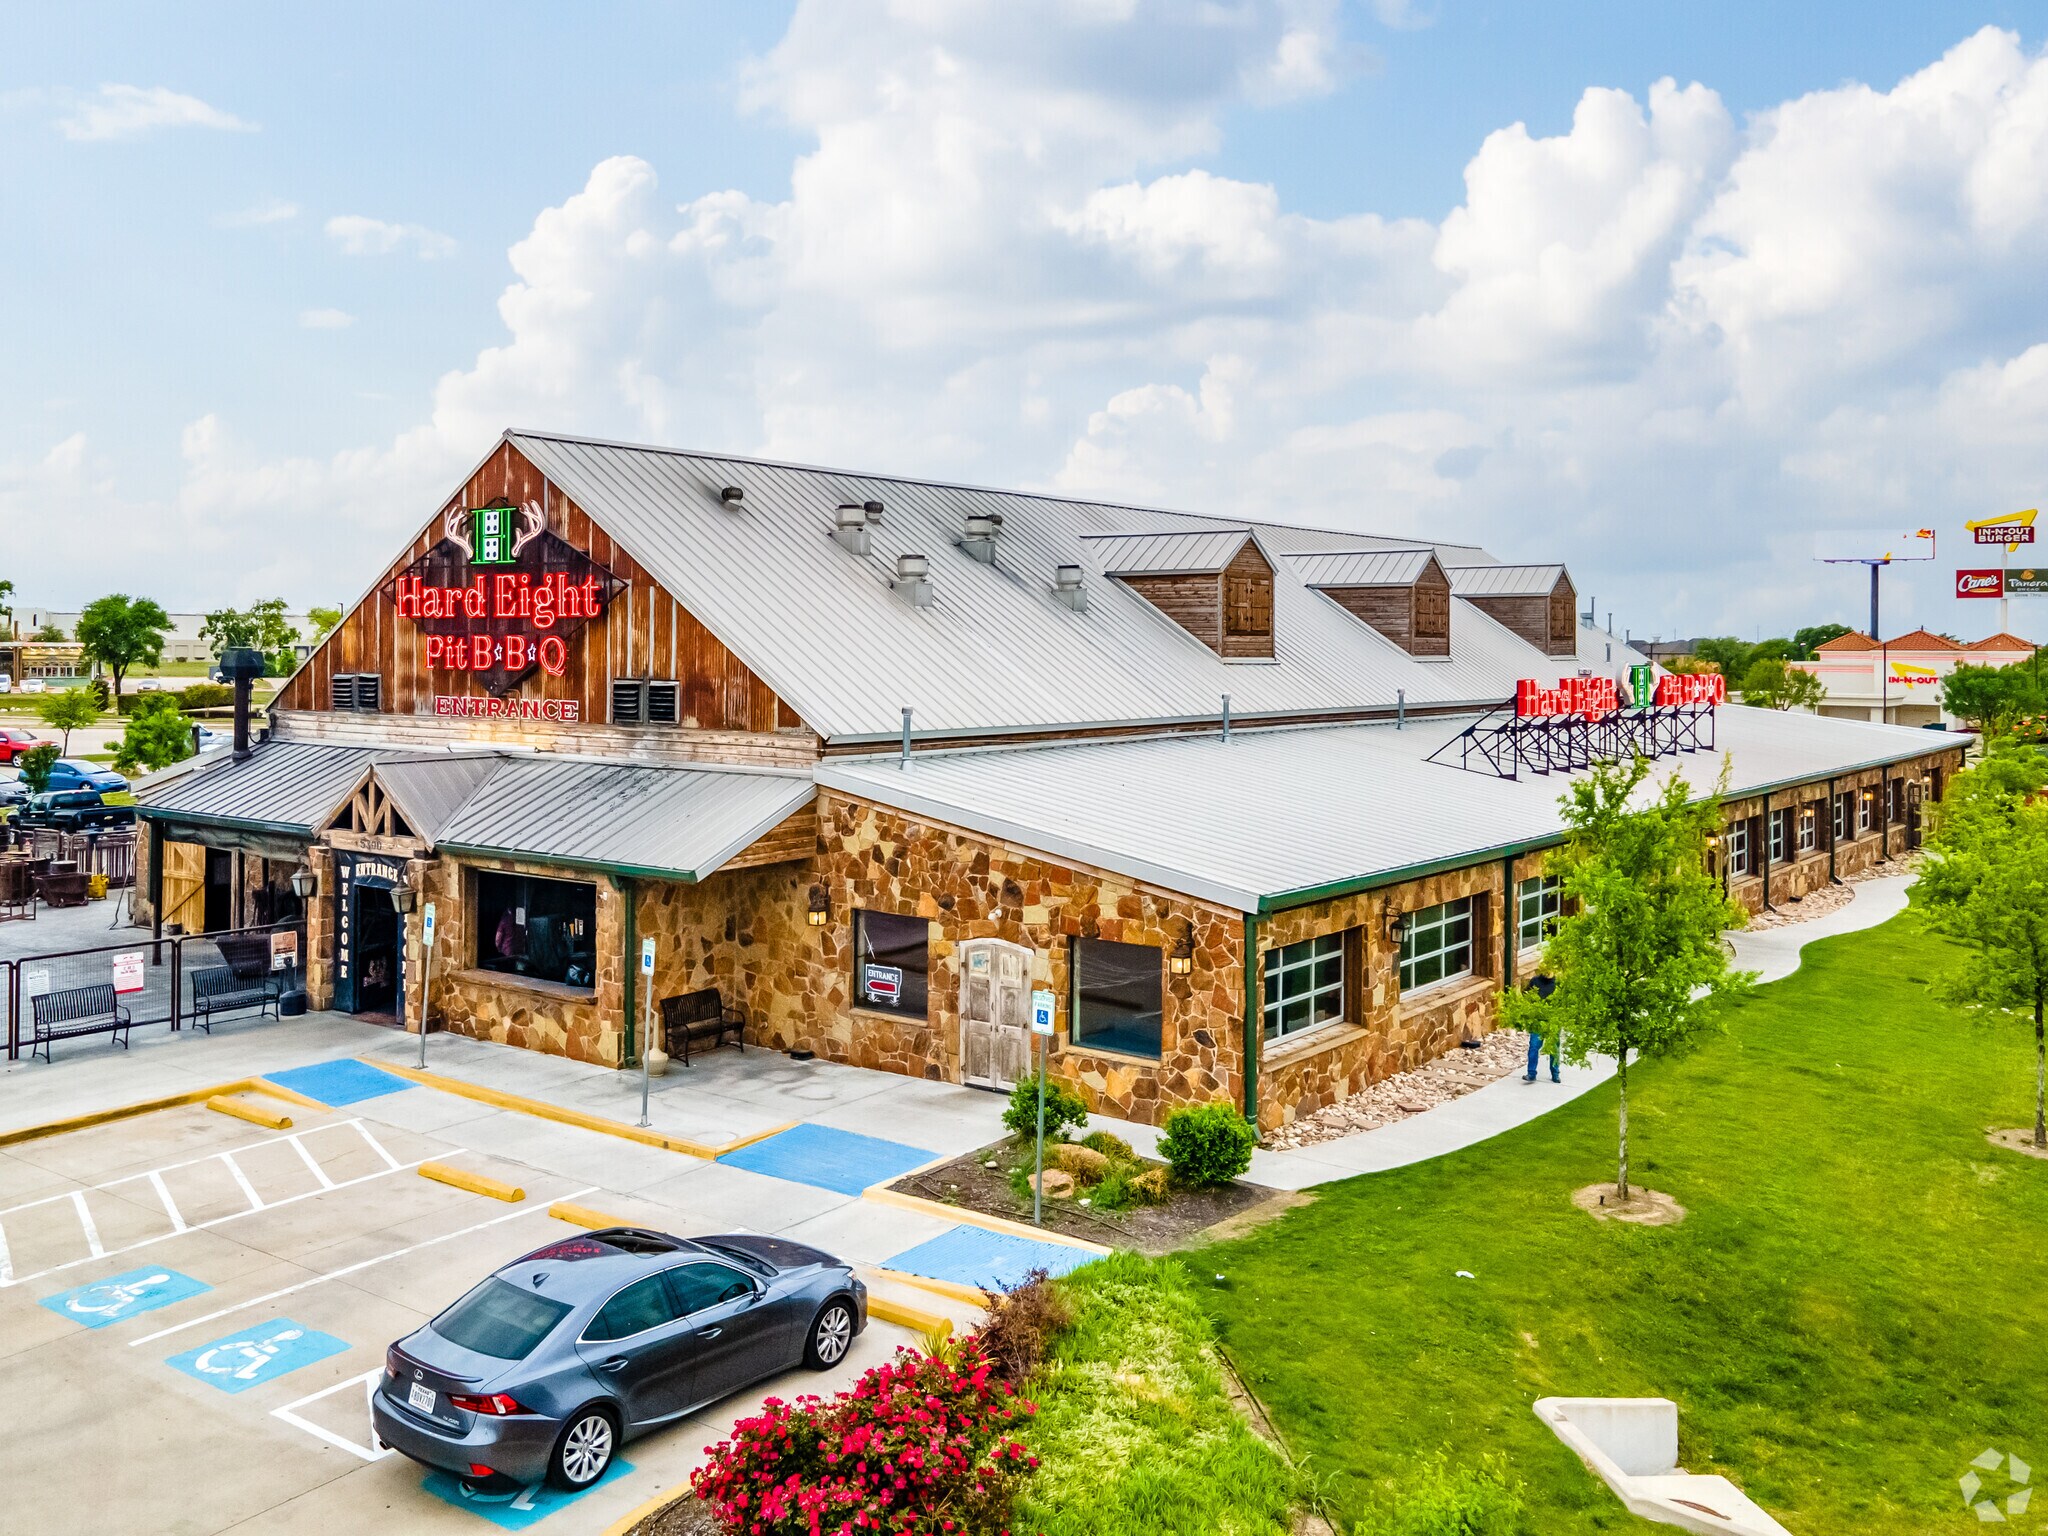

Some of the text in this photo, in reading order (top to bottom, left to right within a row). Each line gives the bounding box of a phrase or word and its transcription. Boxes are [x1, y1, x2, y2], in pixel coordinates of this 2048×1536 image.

[1978, 527, 2031, 535] IN-N-OUT
[1978, 534, 2030, 542] BURGER
[1958, 574, 1999, 592] Cane's
[2008, 578, 2048, 588] Panera
[396, 571, 602, 629] Hard Eight
[424, 634, 468, 671] Pit
[1888, 676, 1939, 684] IN-N-OUT
[1521, 678, 1572, 716] Hard
[1574, 677, 1619, 722] Eight
[1660, 675, 1683, 707] Pit
[434, 695, 580, 722] ENTRANCE
[355, 862, 398, 882] ENTRANCE
[340, 865, 351, 979] WELCOME
[868, 969, 899, 983] ENTRANCE
